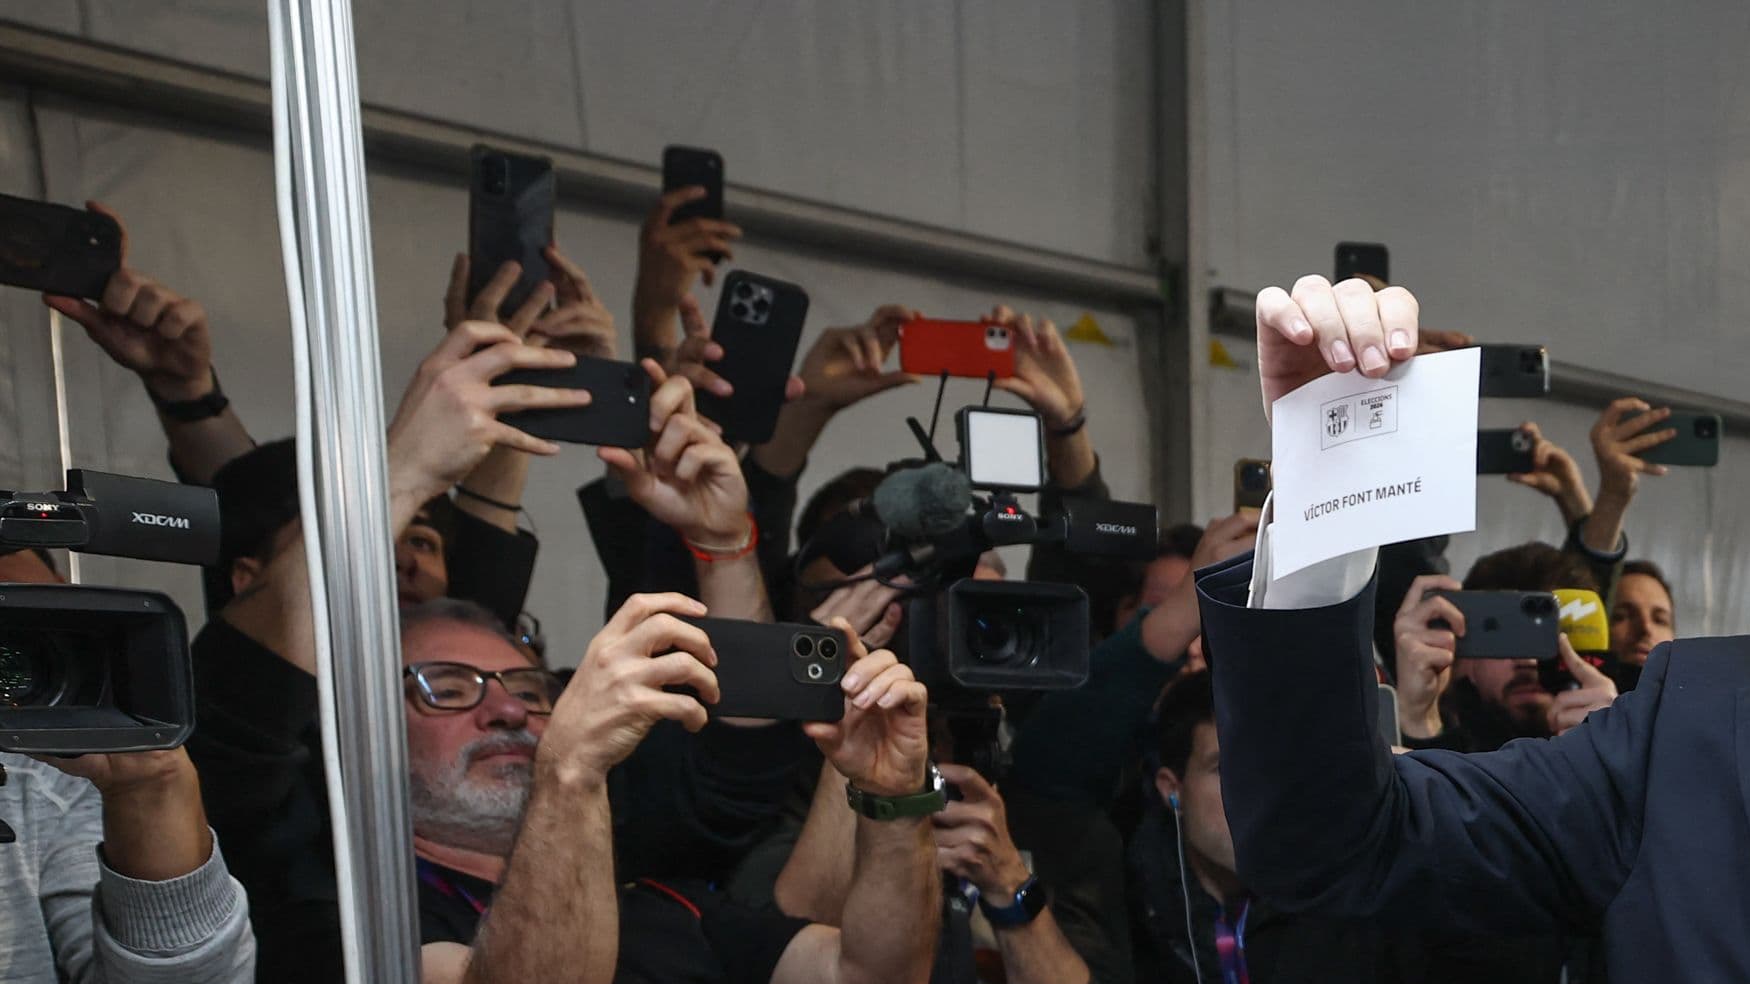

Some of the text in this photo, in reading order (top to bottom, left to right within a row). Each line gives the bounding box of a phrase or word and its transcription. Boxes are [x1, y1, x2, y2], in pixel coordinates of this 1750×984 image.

[1361, 394, 1392, 406] ELECCIONS
[1304, 477, 1422, 521] VÍCTOR FONT MANTÉ
[27, 503, 59, 511] SONY
[132, 512, 190, 529] XDCAM
[998, 512, 1023, 521] SONY
[1096, 522, 1136, 535] XDCAM
